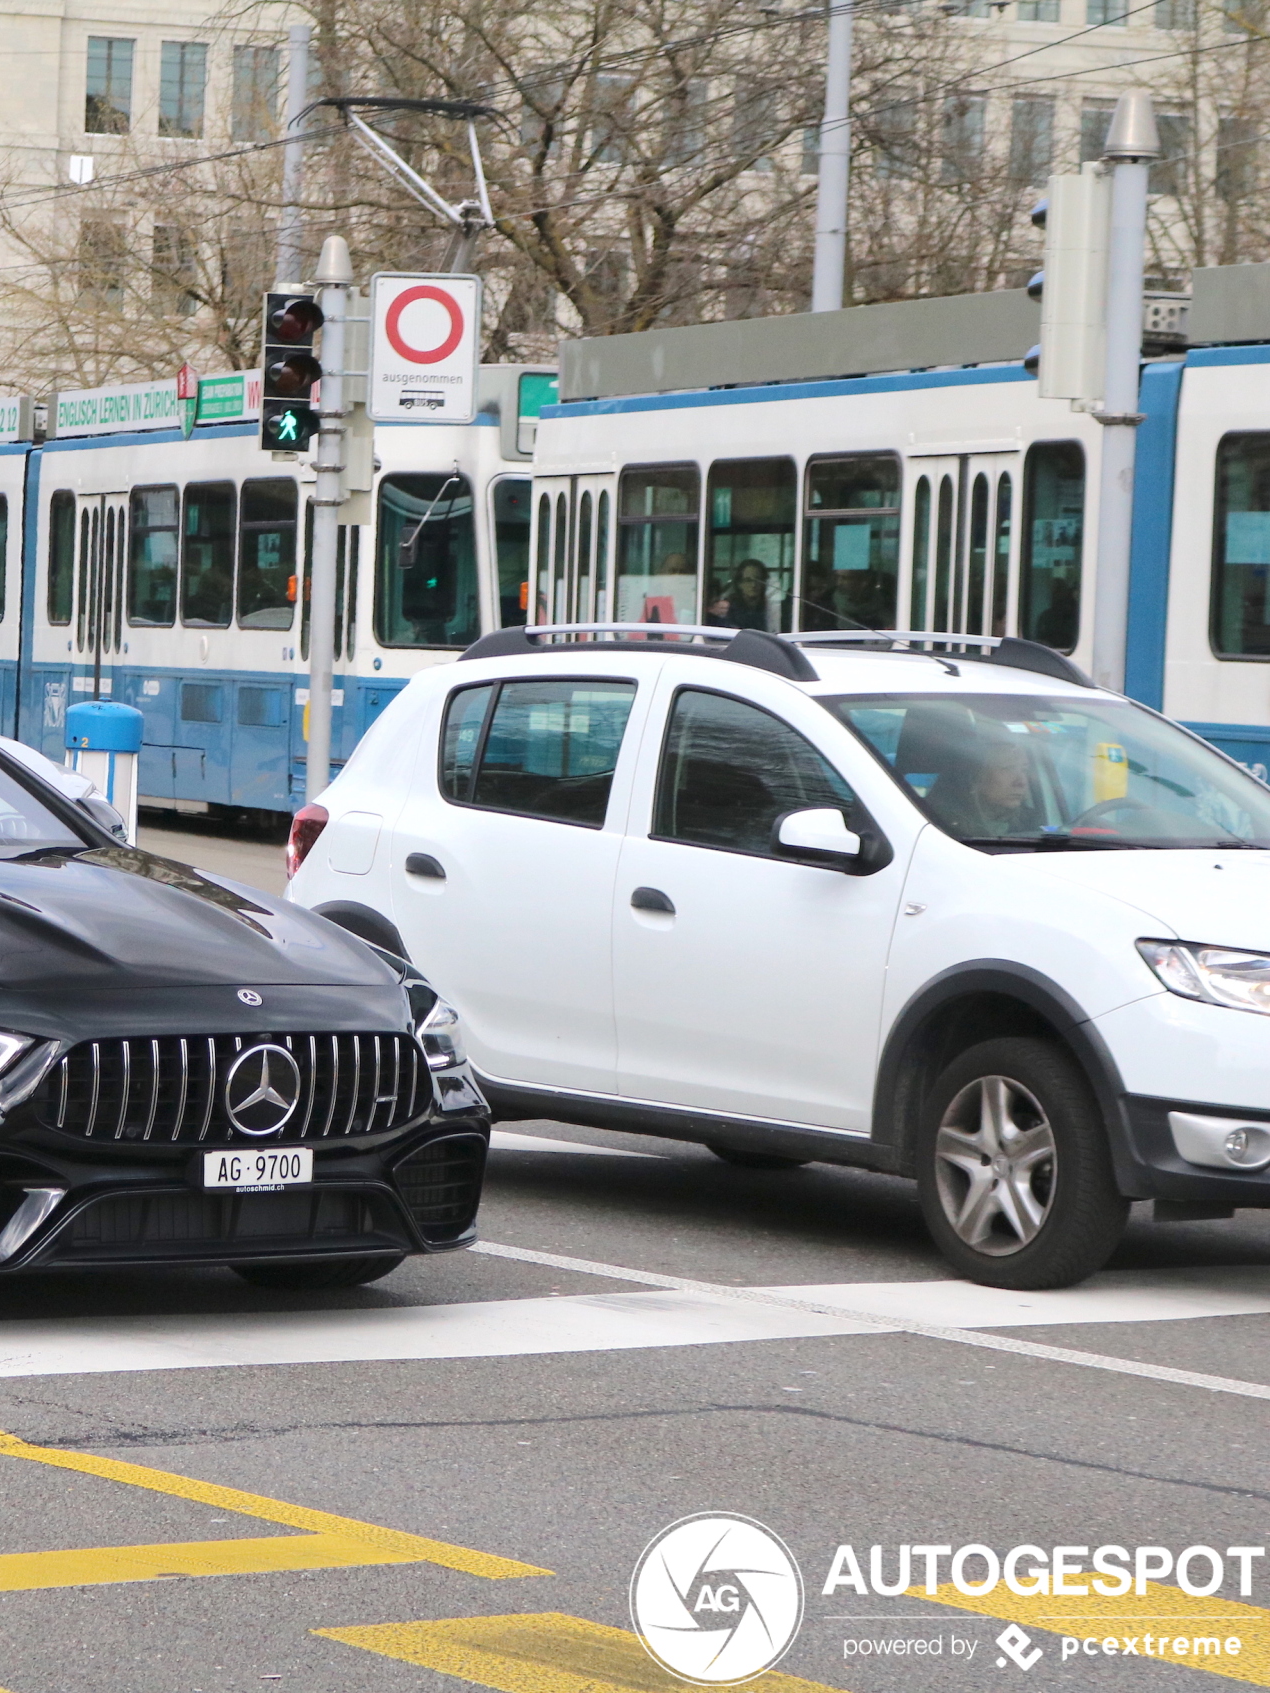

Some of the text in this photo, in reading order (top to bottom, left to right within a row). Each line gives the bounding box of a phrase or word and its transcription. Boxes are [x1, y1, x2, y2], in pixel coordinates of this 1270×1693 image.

[383, 372, 463, 385] ausgenommen
[7, 406, 17, 432] 12
[58, 399, 97, 428] ENGLISCH
[99, 395, 130, 424] LERNEN
[133, 393, 142, 422] IN
[81, 737, 89, 748] 2
[217, 1154, 300, 1182] AG 9700
[236, 1183, 284, 1192] autoschmid.ch
